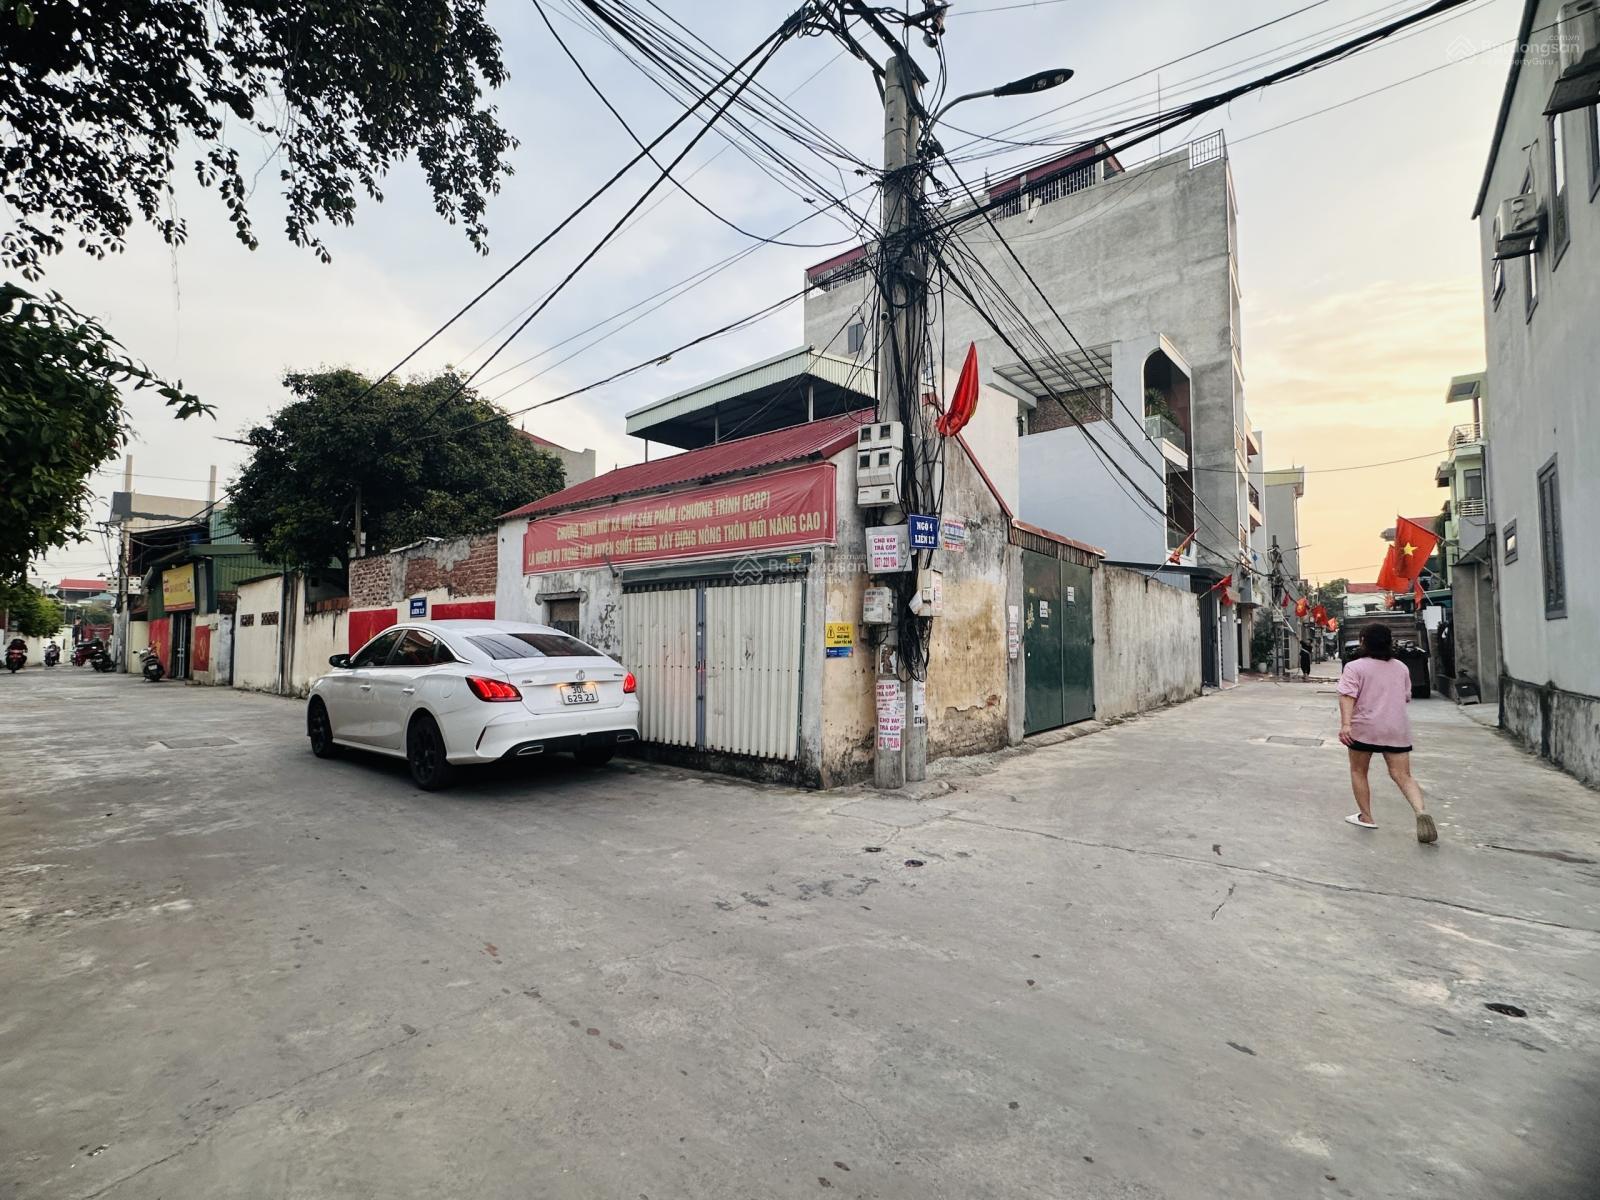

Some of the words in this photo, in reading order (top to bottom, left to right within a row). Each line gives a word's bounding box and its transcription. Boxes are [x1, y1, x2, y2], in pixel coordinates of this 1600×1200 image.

[637, 506, 653, 528] SẢN
[654, 502, 676, 526] PHẨM
[678, 500, 713, 523] (CHƯƠNG
[715, 495, 740, 516] TRÌNH
[634, 535, 656, 552] TRONG
[659, 530, 673, 551] XÂY
[675, 529, 696, 551] DỰNG
[698, 524, 721, 545] NÔNG
[723, 520, 746, 542] THÔN
[748, 515, 766, 539] MỚI
[769, 513, 797, 537] NÂNG
[799, 511, 821, 532] CAO
